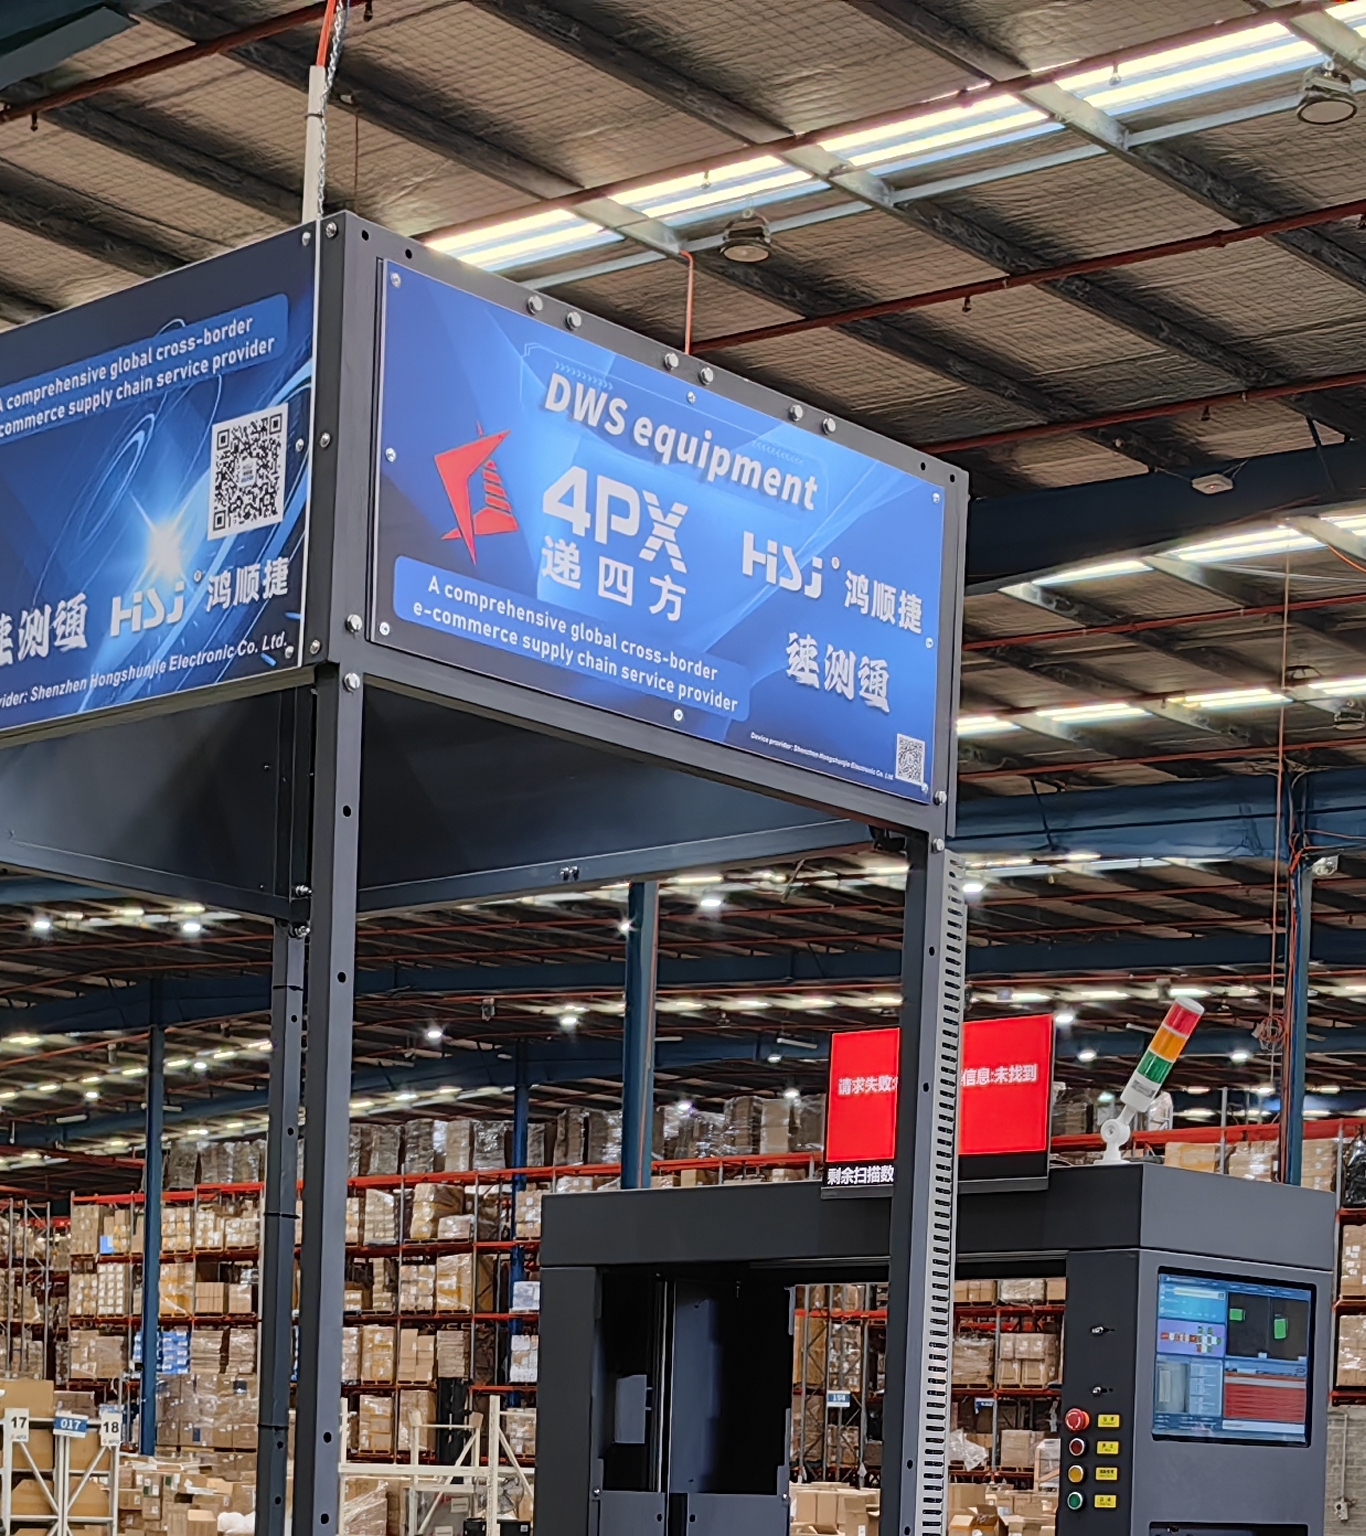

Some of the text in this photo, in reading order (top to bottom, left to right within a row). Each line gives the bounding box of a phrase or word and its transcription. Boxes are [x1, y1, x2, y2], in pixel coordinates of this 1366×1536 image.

[7, 365, 106, 410] comprehensive
[110, 348, 153, 383] global
[155, 316, 253, 361] cross-border
[68, 388, 112, 420] supply
[116, 373, 153, 399] chain
[156, 360, 209, 387] service
[212, 336, 275, 374] provider
[545, 371, 818, 512] DWS equipment
[542, 464, 687, 574] 4PX
[205, 556, 290, 613] 鸿顺捷
[541, 535, 687, 622] 递四方
[844, 568, 923, 635] 鸿顺捷
[30, 677, 87, 703] Shenzhen
[89, 660, 167, 691] Hongshunjie
[169, 645, 235, 671] Electronic
[236, 639, 260, 657] Co.
[262, 631, 288, 652] Ltd.
[413, 601, 738, 713] e-commerce supply chain service provider
[428, 576, 717, 681] A comprehensive global cross-border
[961, 1063, 1038, 1087] 信息:未找到
[11, 1416, 27, 1429] 17
[60, 1418, 82, 1431] 017
[103, 1421, 119, 1433] 18
